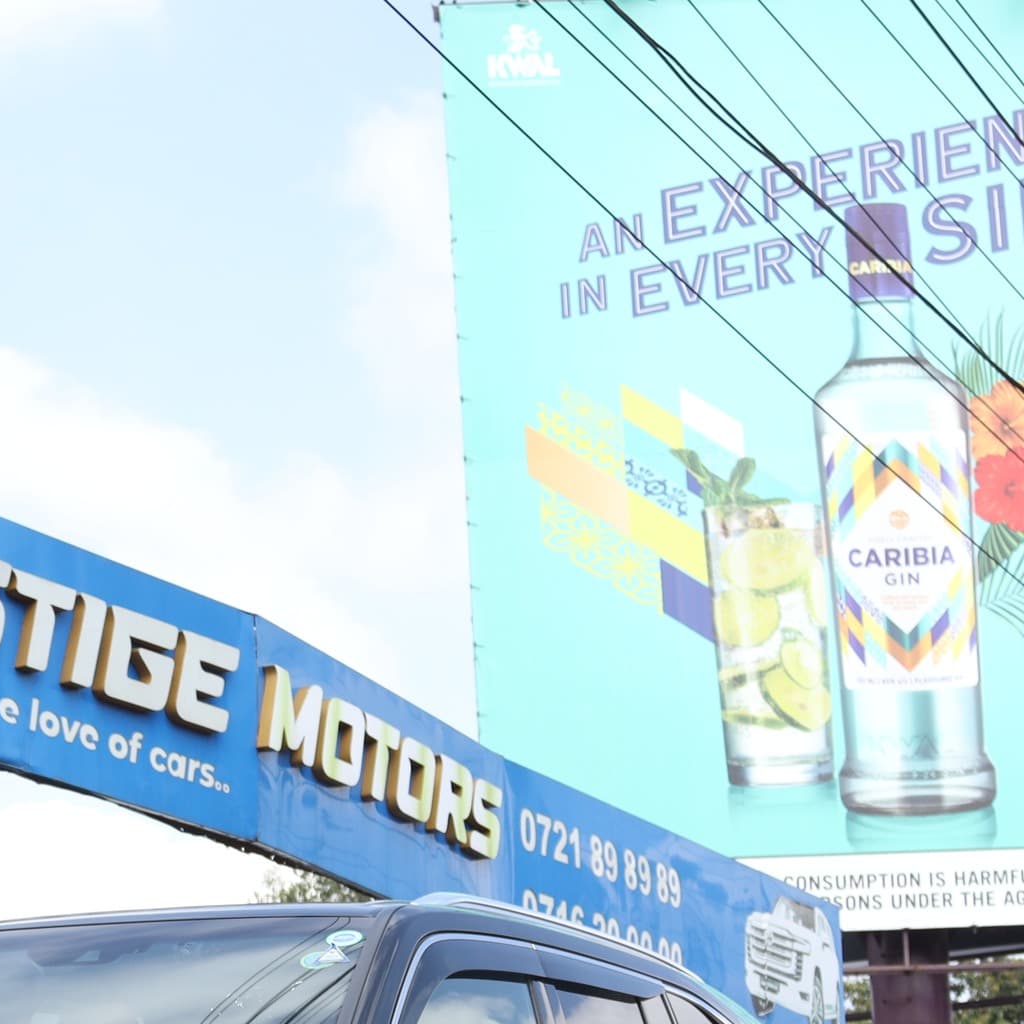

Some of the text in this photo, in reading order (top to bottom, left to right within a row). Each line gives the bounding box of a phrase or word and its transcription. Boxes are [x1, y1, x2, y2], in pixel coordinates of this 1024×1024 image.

[486, 50, 561, 79] KWAL
[578, 107, 1024, 263] AN EXPERIEN
[560, 178, 1024, 319] IN EVERY SI
[848, 545, 955, 568] CARIBIA
[884, 571, 921, 587] GIN
[29, 703, 98, 752] love
[107, 732, 143, 765] of
[256, 664, 503, 860] MOTORS
[520, 808, 682, 909] 0721 89 89 89
[929, 871, 946, 888] IS
[821, 894, 884, 911] SONS
[890, 891, 953, 910] UNDER
[959, 890, 996, 908] THE
